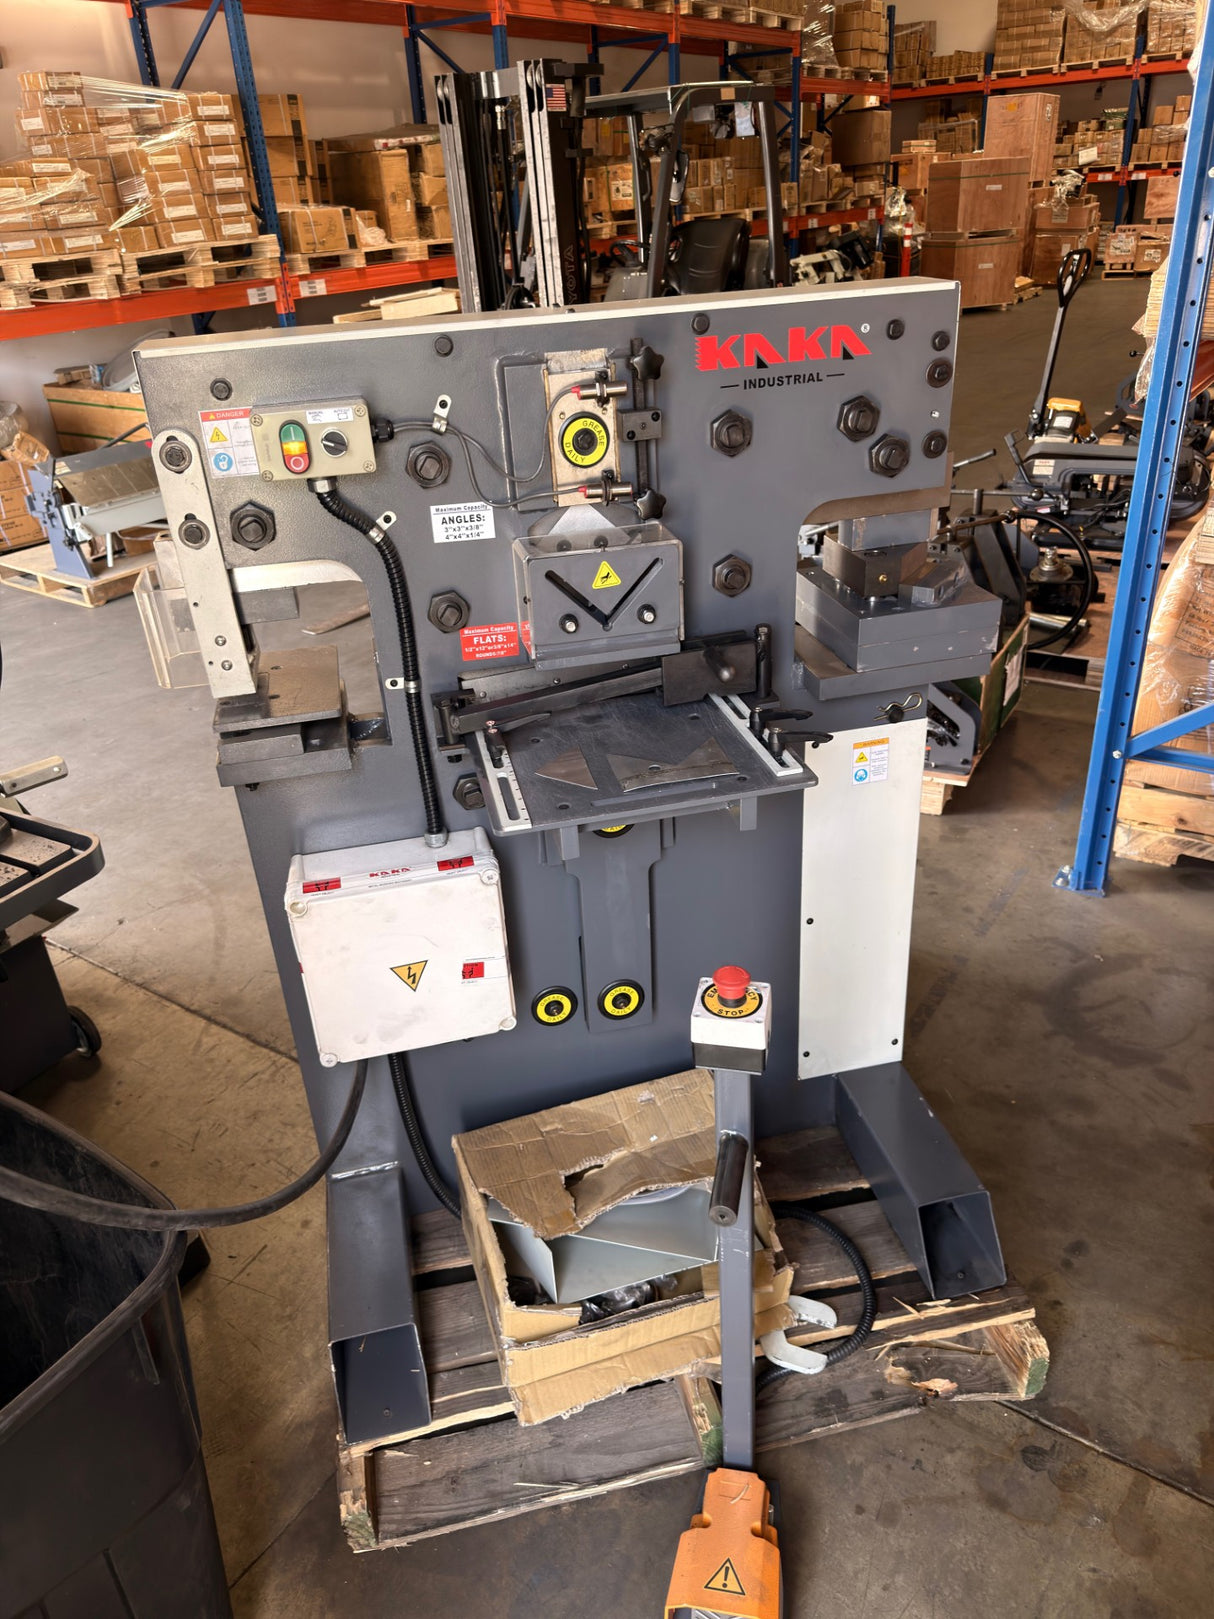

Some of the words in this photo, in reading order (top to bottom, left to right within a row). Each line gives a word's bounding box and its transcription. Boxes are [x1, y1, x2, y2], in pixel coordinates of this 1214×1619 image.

[564, 245, 577, 304] YOTA
[694, 324, 872, 371] KAKA
[743, 372, 823, 390] INDUSTRIAL
[583, 420, 604, 446] GREASE
[565, 442, 585, 463] DAILY
[441, 513, 486, 525] ANGLES:
[490, 625, 514, 633] Capacity
[473, 634, 507, 645] FLATS:
[717, 1008, 744, 1017] STOP
